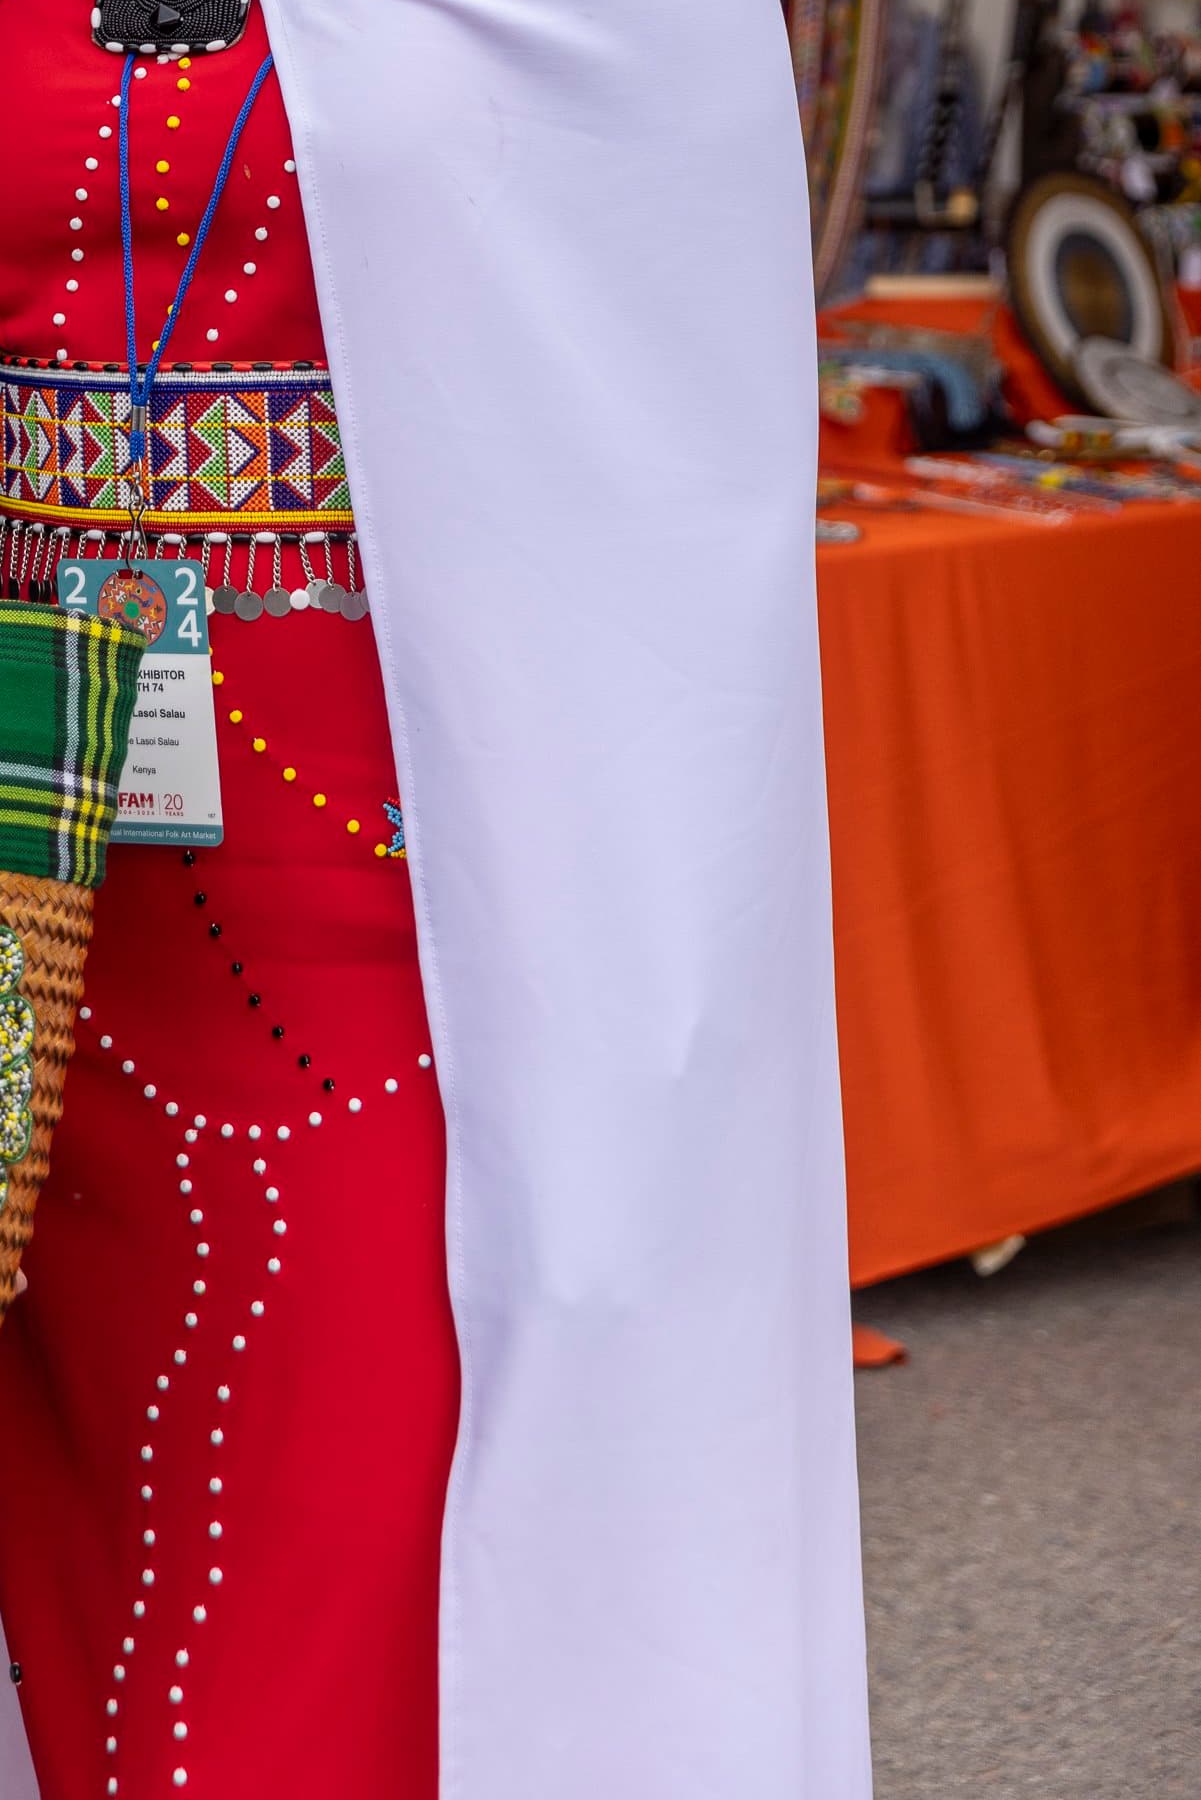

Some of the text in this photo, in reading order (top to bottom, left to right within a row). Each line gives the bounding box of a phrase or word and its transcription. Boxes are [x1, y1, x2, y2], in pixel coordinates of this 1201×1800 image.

[64, 567, 87, 604] 2
[137, 670, 185, 680] XHIBITOR
[152, 683, 164, 692] 74
[160, 709, 185, 719] Salau
[158, 737, 179, 746] Salau
[132, 765, 156, 775] Kenya
[118, 792, 154, 808] FAM
[164, 794, 184, 810] 20
[123, 829, 164, 838] International
[165, 830, 179, 838] Folk
[193, 831, 216, 840] Market
